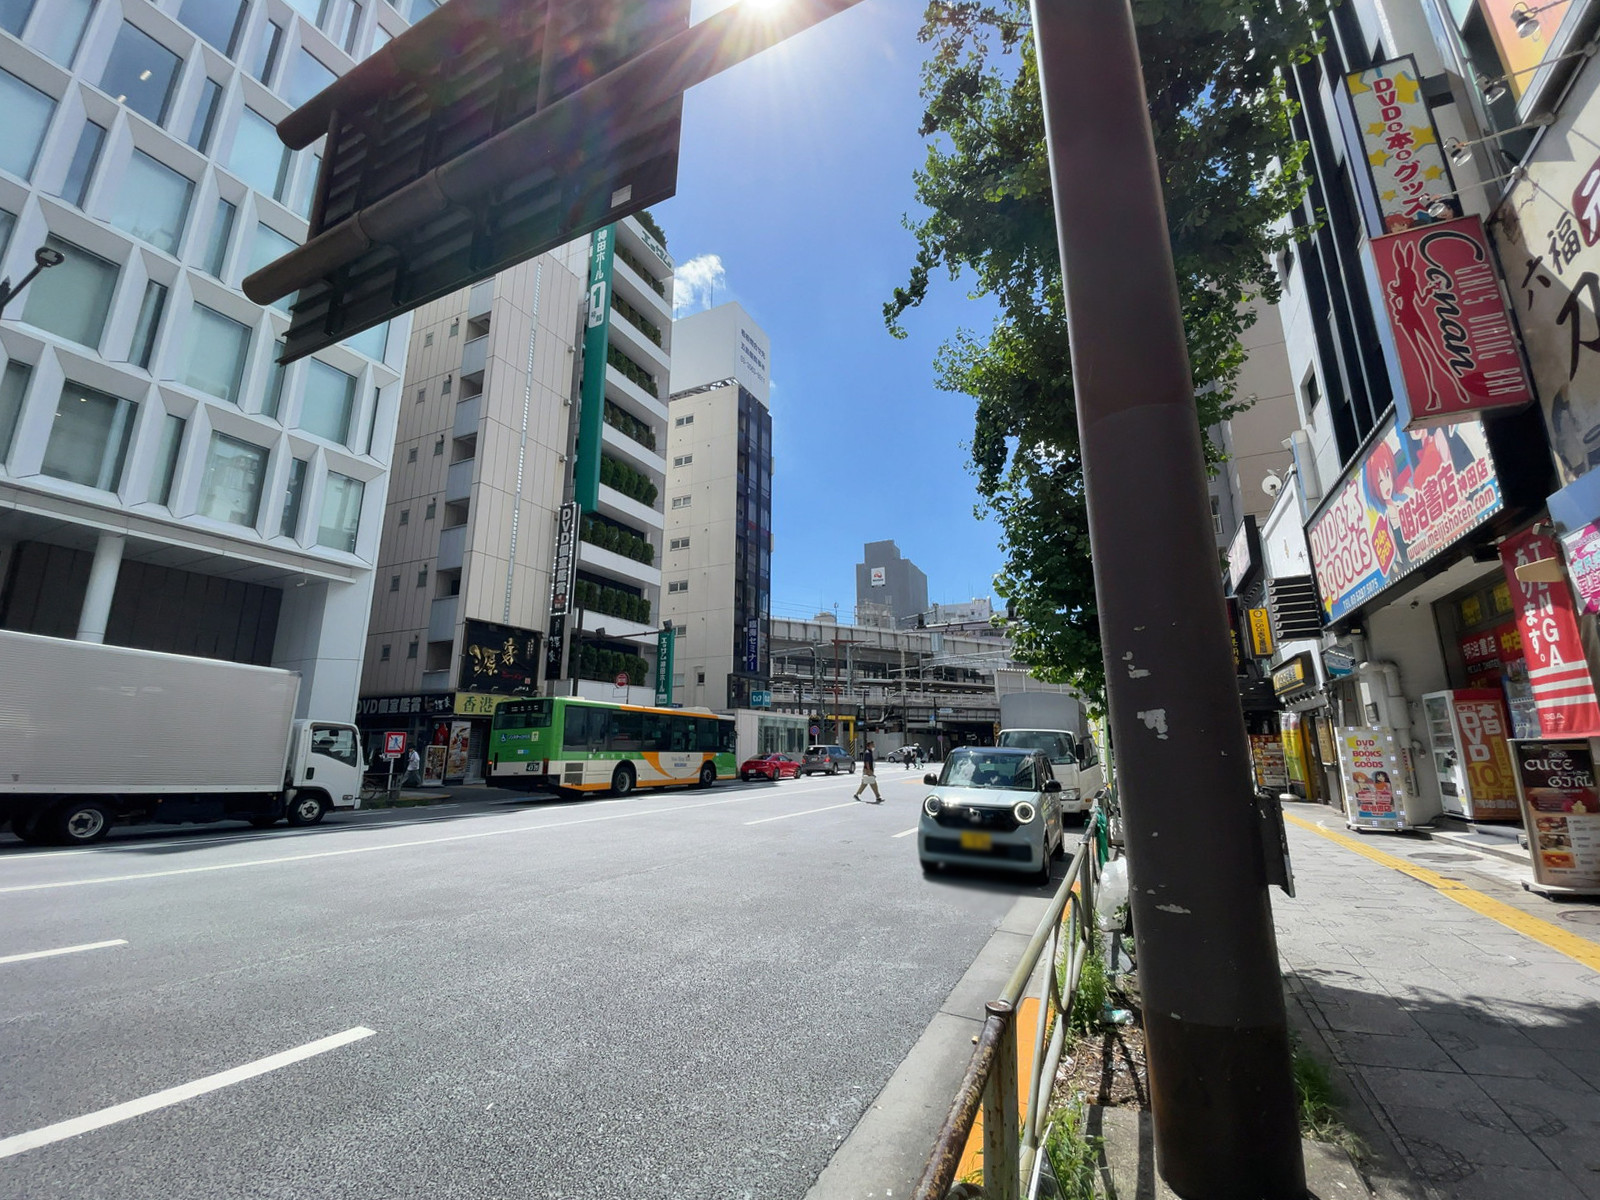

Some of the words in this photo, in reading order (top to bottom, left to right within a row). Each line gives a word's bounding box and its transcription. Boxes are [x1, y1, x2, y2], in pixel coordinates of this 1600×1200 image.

[594, 229, 608, 281] 神田ホール
[1418, 230, 1484, 377] Conan
[1483, 367, 1526, 397] BAR
[1399, 462, 1459, 543] 明治書店
[1457, 457, 1490, 497] 神田店
[464, 696, 493, 712] 香港
[1459, 712, 1490, 762] DVD
[1524, 759, 1574, 771] CUTE
[1548, 775, 1594, 787] GIRL
